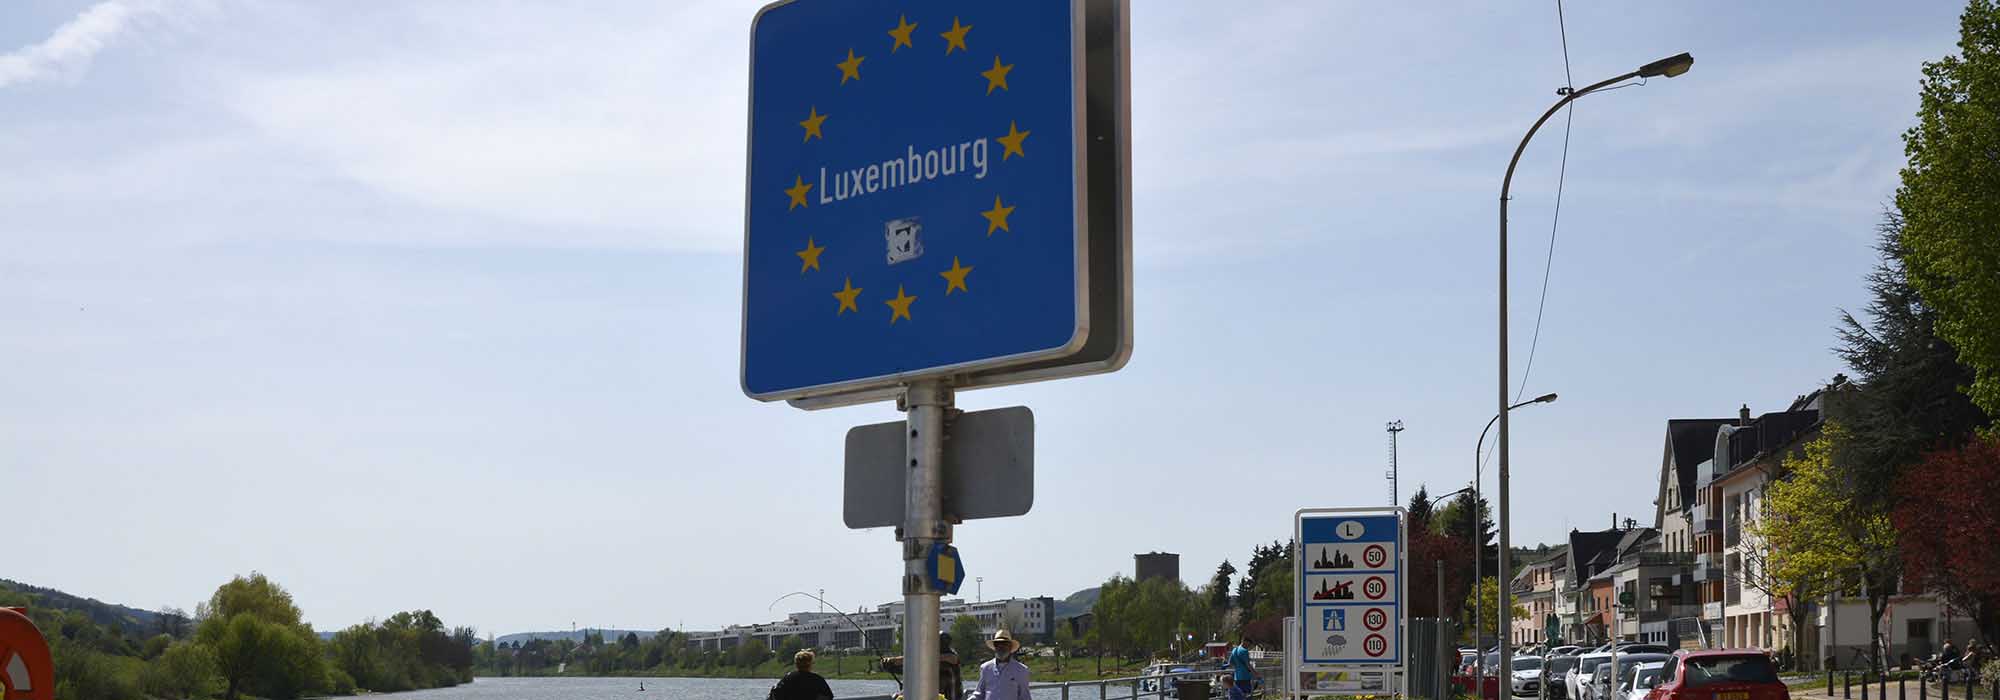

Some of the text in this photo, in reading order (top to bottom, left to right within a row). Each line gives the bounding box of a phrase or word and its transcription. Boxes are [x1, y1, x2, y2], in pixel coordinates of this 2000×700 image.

[820, 137, 988, 204] Luxembourg
[1346, 524, 1354, 536] L
[1368, 551, 1381, 562] 50
[1368, 583, 1381, 593] 90
[1368, 614, 1382, 625] 130
[1368, 640, 1382, 650] 110
